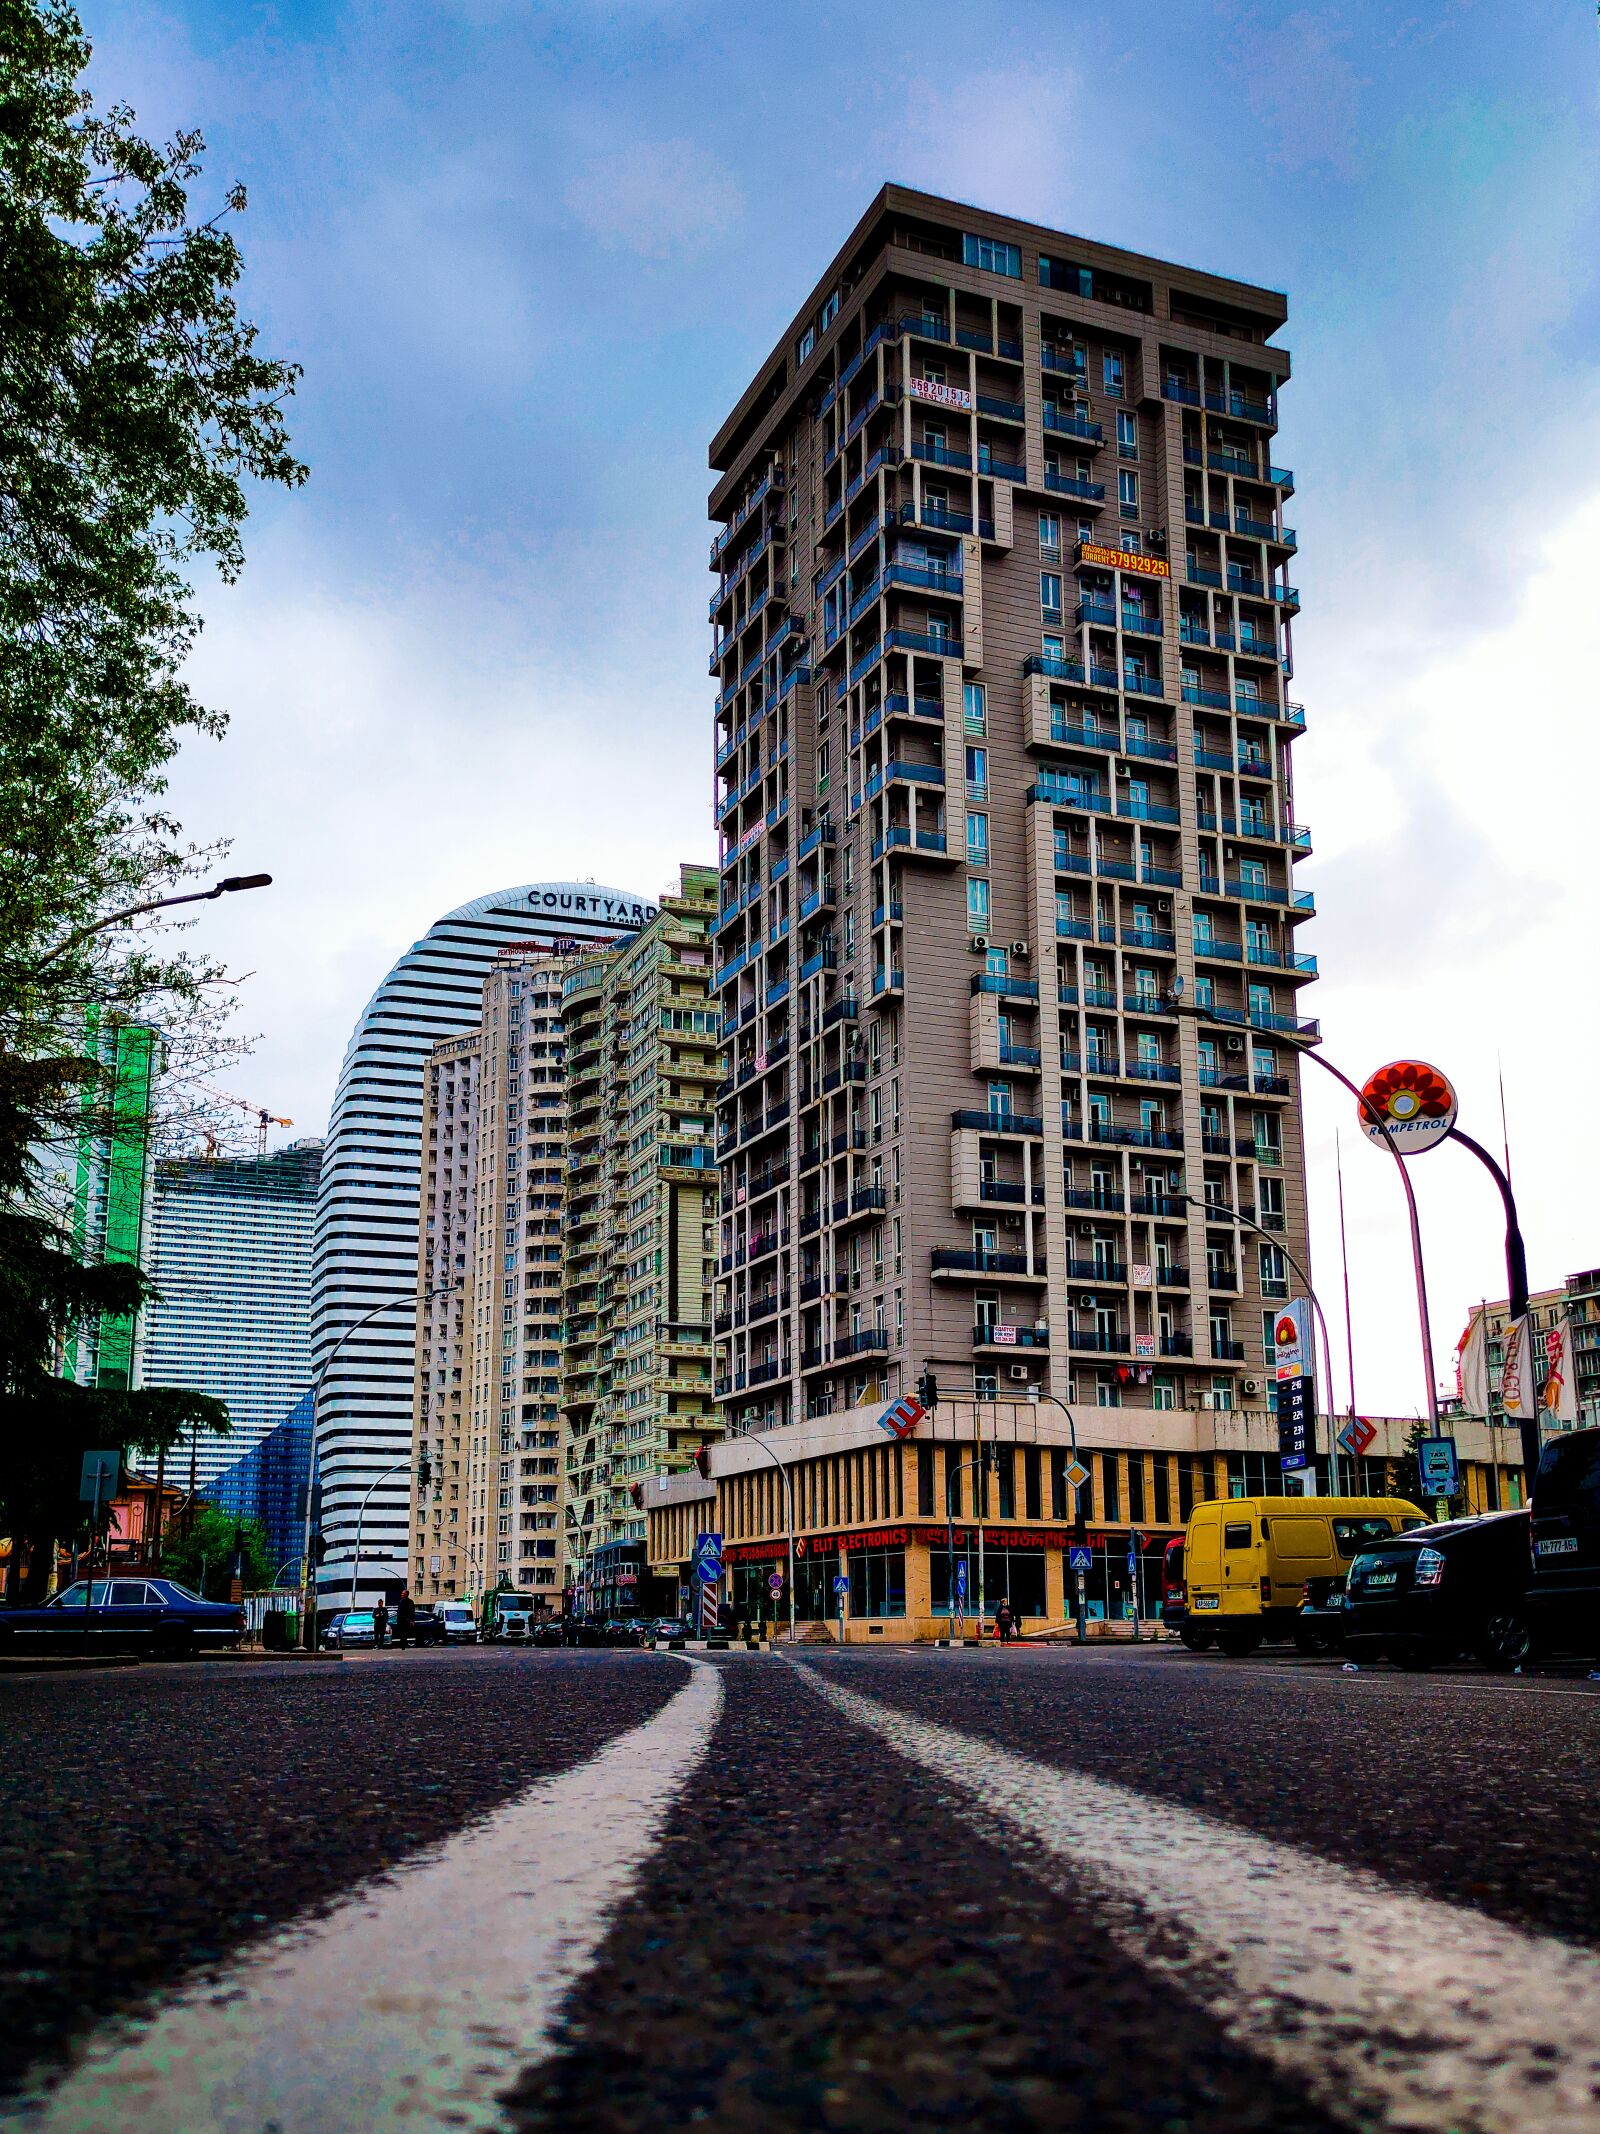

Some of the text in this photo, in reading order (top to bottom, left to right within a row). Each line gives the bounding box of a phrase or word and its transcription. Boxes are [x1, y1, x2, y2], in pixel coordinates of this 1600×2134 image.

[911, 379, 970, 403] 558 20 15 13
[919, 391, 937, 400] RENT
[528, 891, 657, 919] COURTYARD
[813, 1536, 834, 1553] ELIT
[837, 1528, 907, 1550] ELECTRONICS
